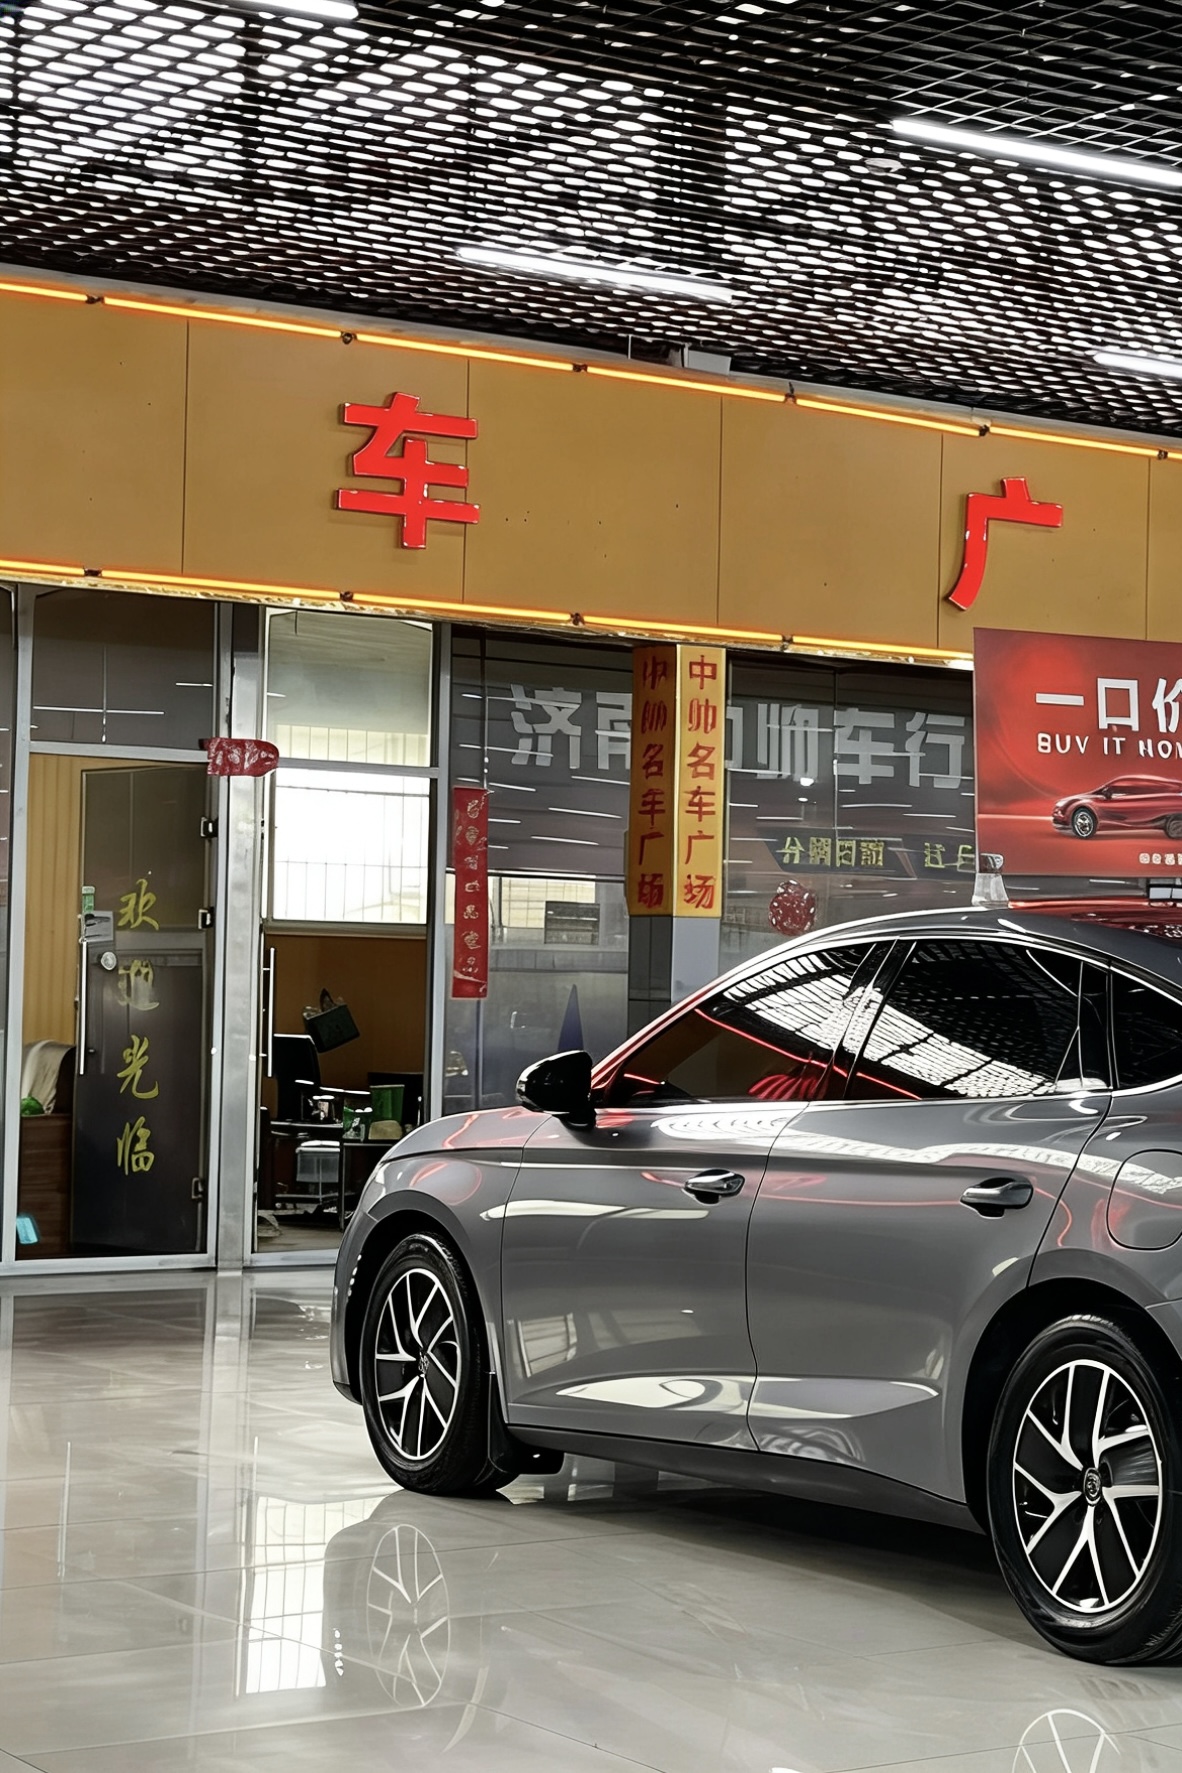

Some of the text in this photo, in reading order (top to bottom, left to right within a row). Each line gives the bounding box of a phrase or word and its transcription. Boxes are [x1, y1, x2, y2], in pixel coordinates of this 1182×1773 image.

[683, 654, 718, 910] 中帅名车广场
[1103, 736, 1127, 756] IT
